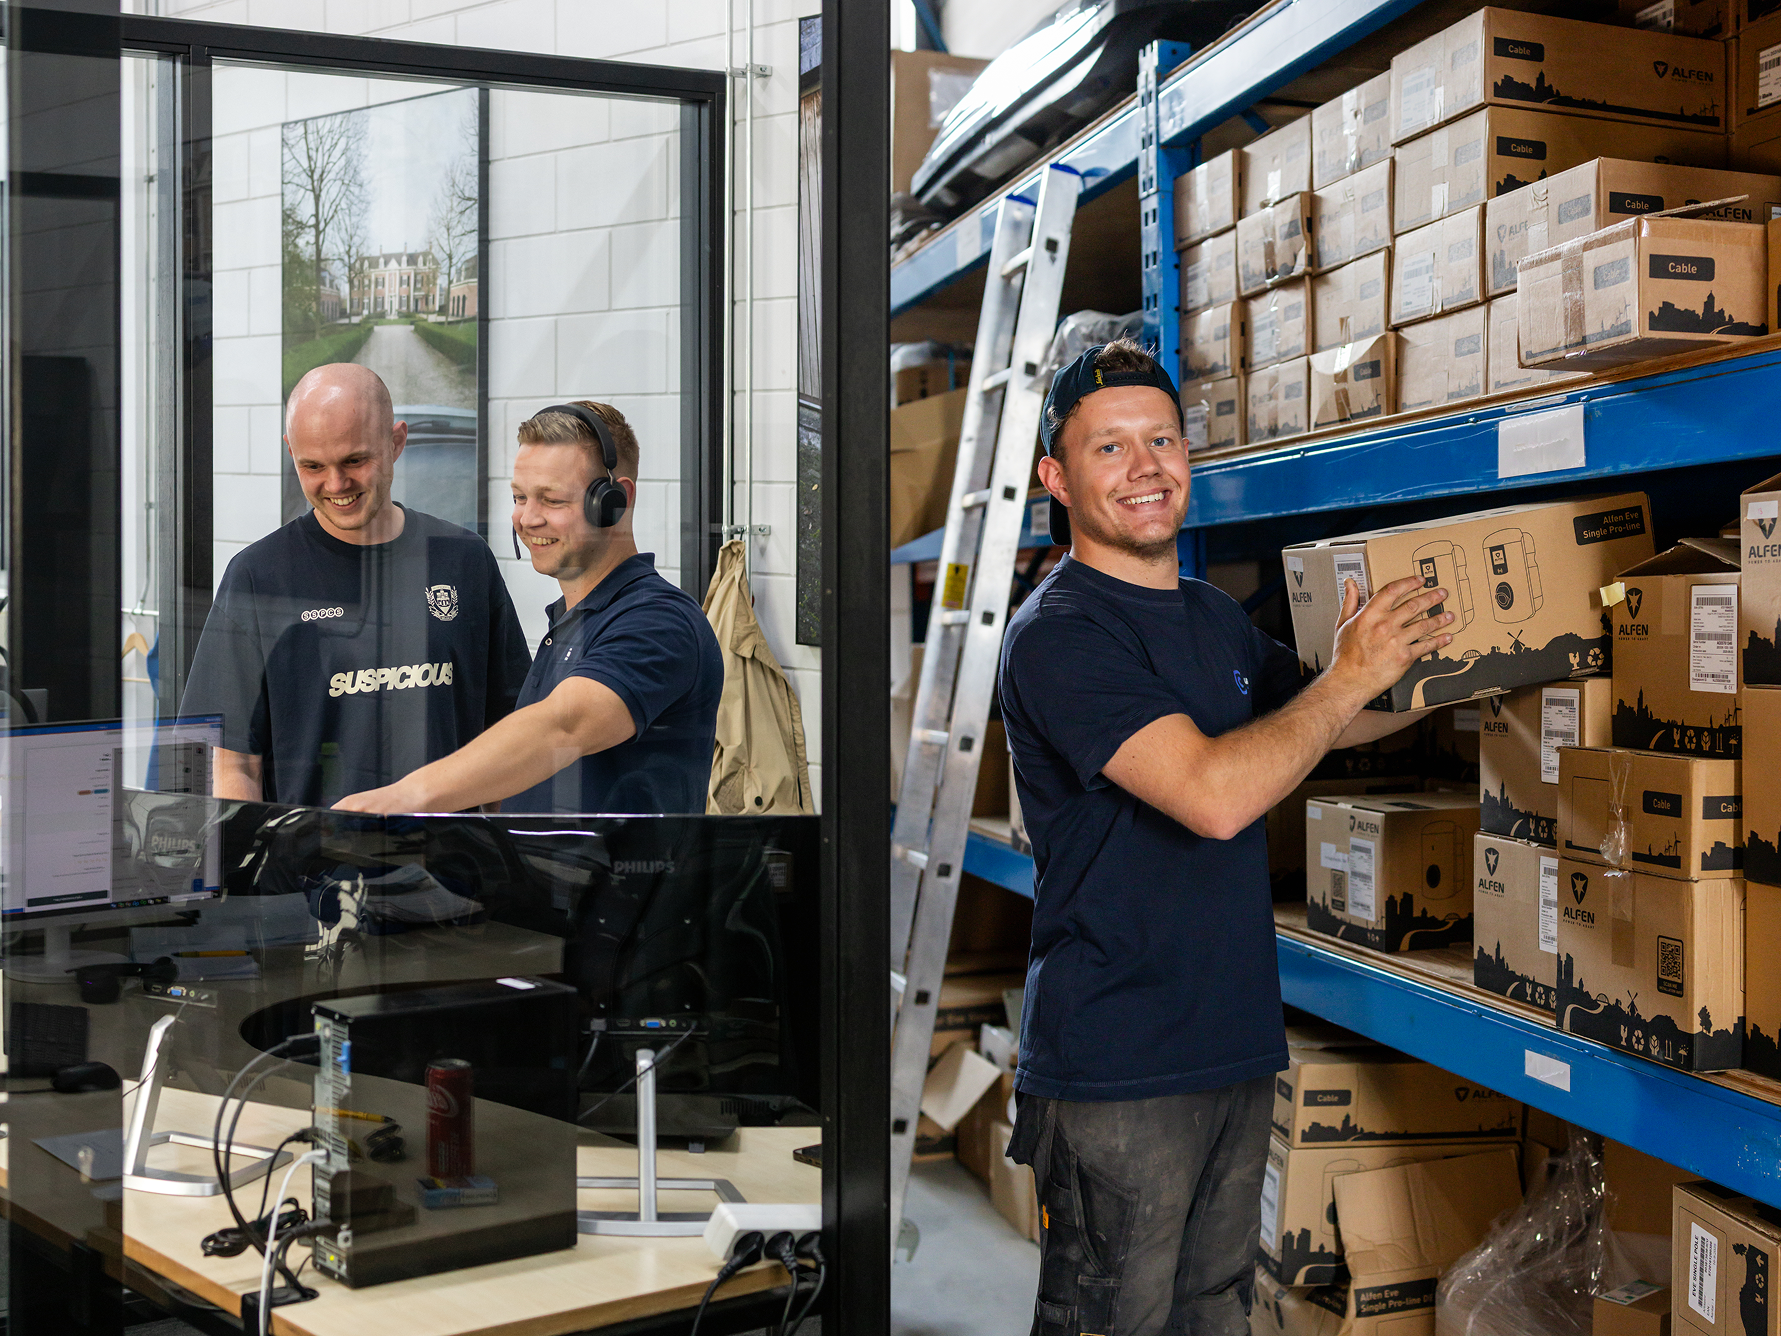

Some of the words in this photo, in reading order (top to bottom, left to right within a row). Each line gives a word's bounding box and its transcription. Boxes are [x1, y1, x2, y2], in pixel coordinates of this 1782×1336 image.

[1508, 44, 1531, 56] Cable
[1672, 67, 1714, 82] ALFEN
[1511, 143, 1533, 154] Cable
[1625, 199, 1650, 210] Cable
[1509, 220, 1529, 237] ALFE
[1668, 262, 1698, 274] Cable
[1603, 515, 1624, 524] Alfen
[1625, 511, 1639, 520] Eve
[1583, 527, 1608, 539] Single
[1609, 522, 1641, 534] Pro-line
[1292, 592, 1313, 603] ALFEN
[1619, 624, 1649, 636] ALFEN
[328, 661, 454, 697] SUSPICIOUS
[1484, 721, 1509, 733] ALFEN
[1653, 798, 1671, 810] Cable
[1720, 802, 1742, 812] Cabl
[1357, 821, 1380, 834] ALFEN
[152, 836, 197, 851] PHILIPS
[614, 860, 676, 874] PHILIPS
[1478, 878, 1505, 893] ALFEN
[1563, 906, 1595, 924] ALFEN
[1317, 1094, 1339, 1102] Cable
[1472, 1089, 1507, 1098] ALFE
[1361, 1291, 1383, 1301] Alfen
[1384, 1289, 1400, 1298] Eve
[1361, 1301, 1387, 1313] Single
[1388, 1297, 1421, 1308] Pro-line
